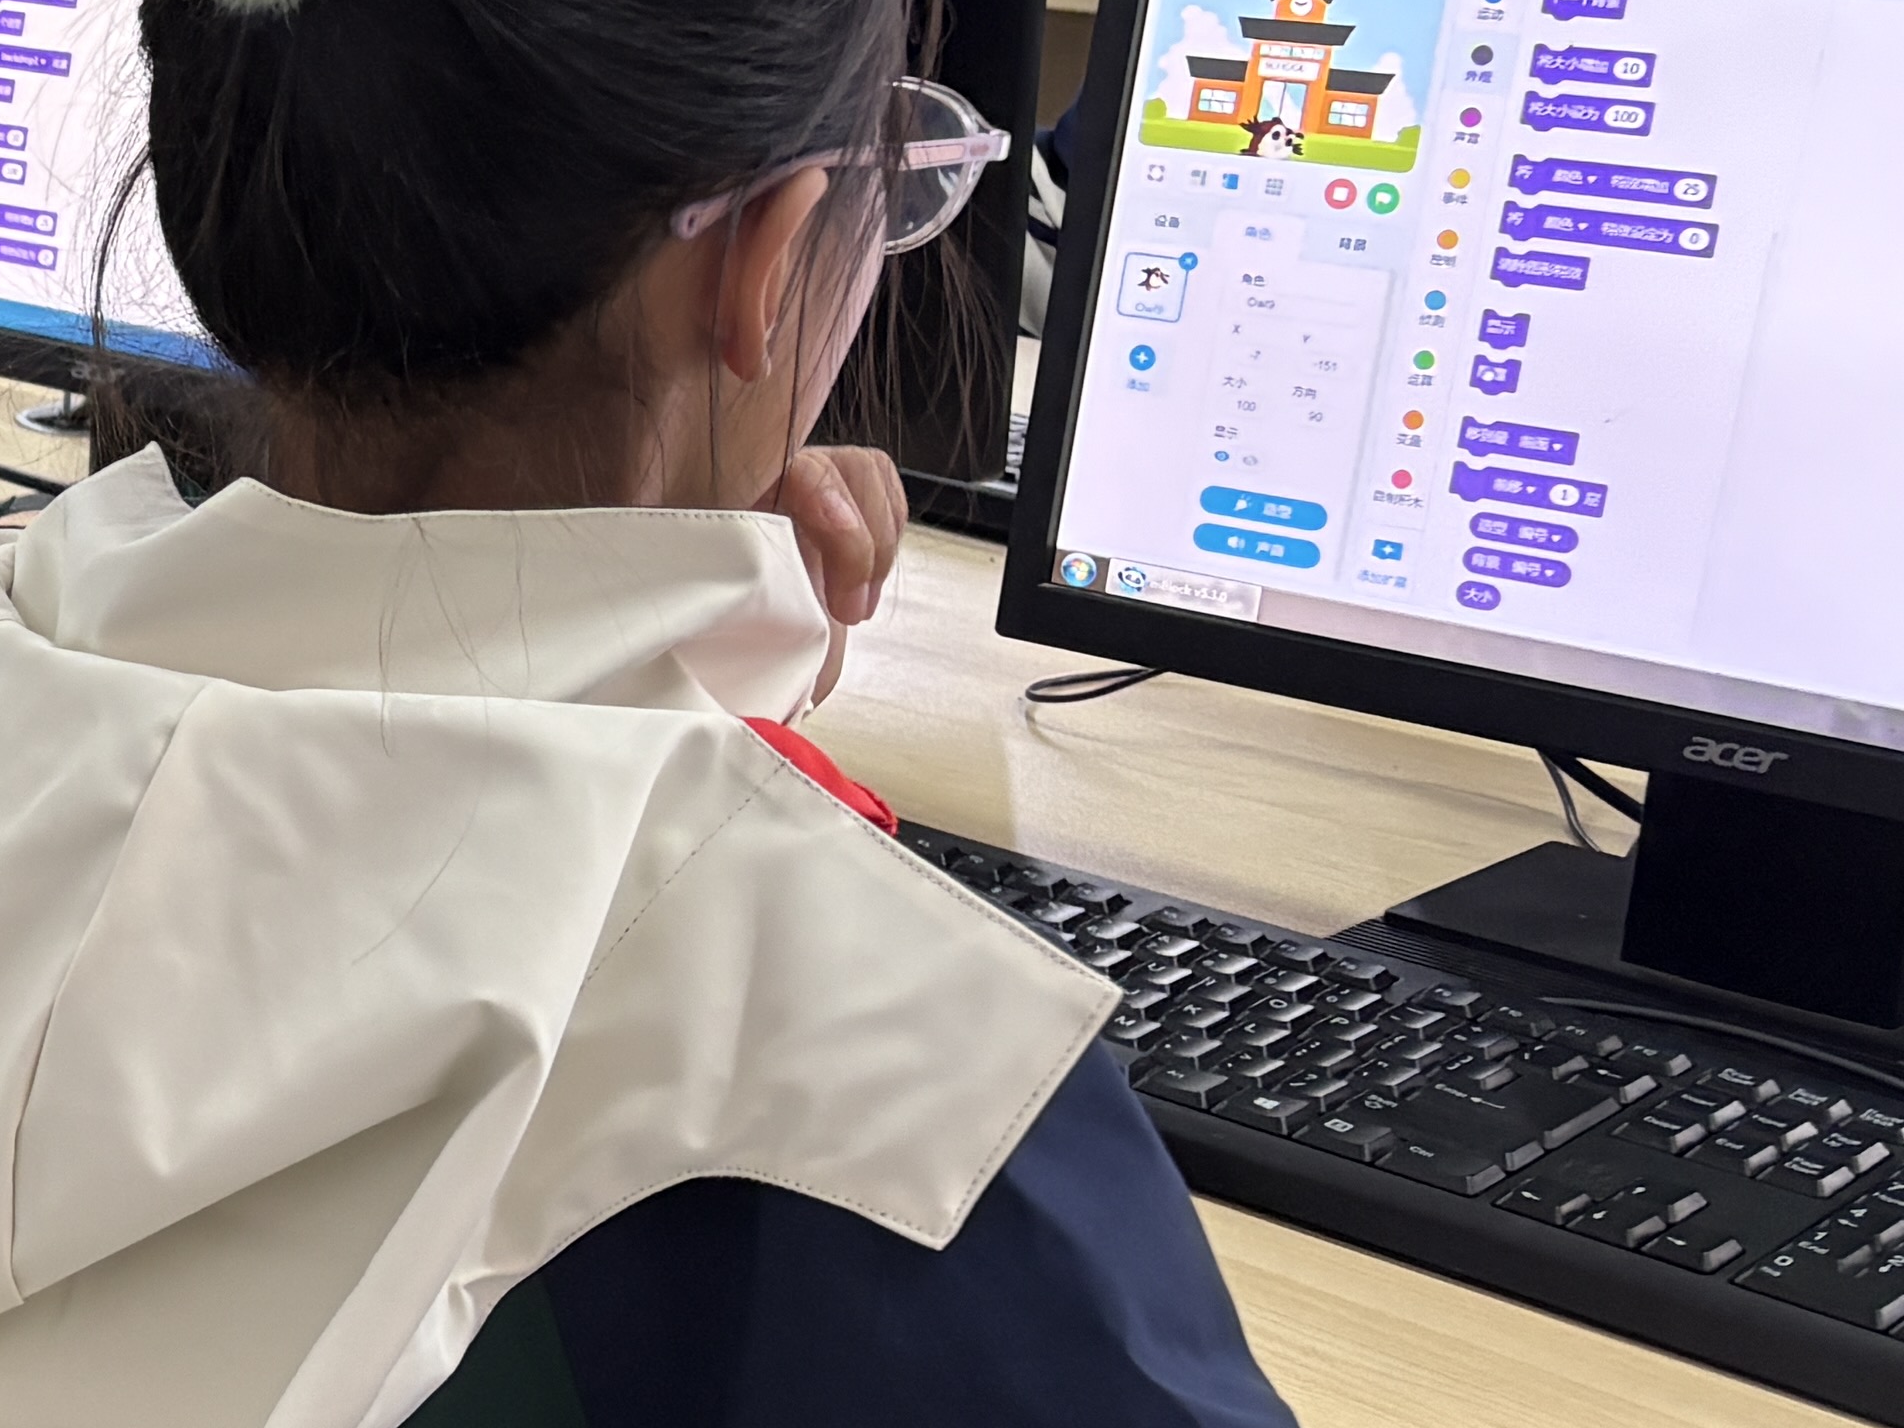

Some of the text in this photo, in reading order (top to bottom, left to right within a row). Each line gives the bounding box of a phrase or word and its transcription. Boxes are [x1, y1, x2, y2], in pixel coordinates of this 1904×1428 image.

[1622, 63, 1639, 74] 10
[1612, 110, 1639, 124] 100
[1690, 232, 1700, 245] 0
[1222, 376, 1247, 389] 大小
[1237, 400, 1257, 412] 100
[1463, 586, 1493, 603] 大小
[1683, 736, 1790, 773] acer
